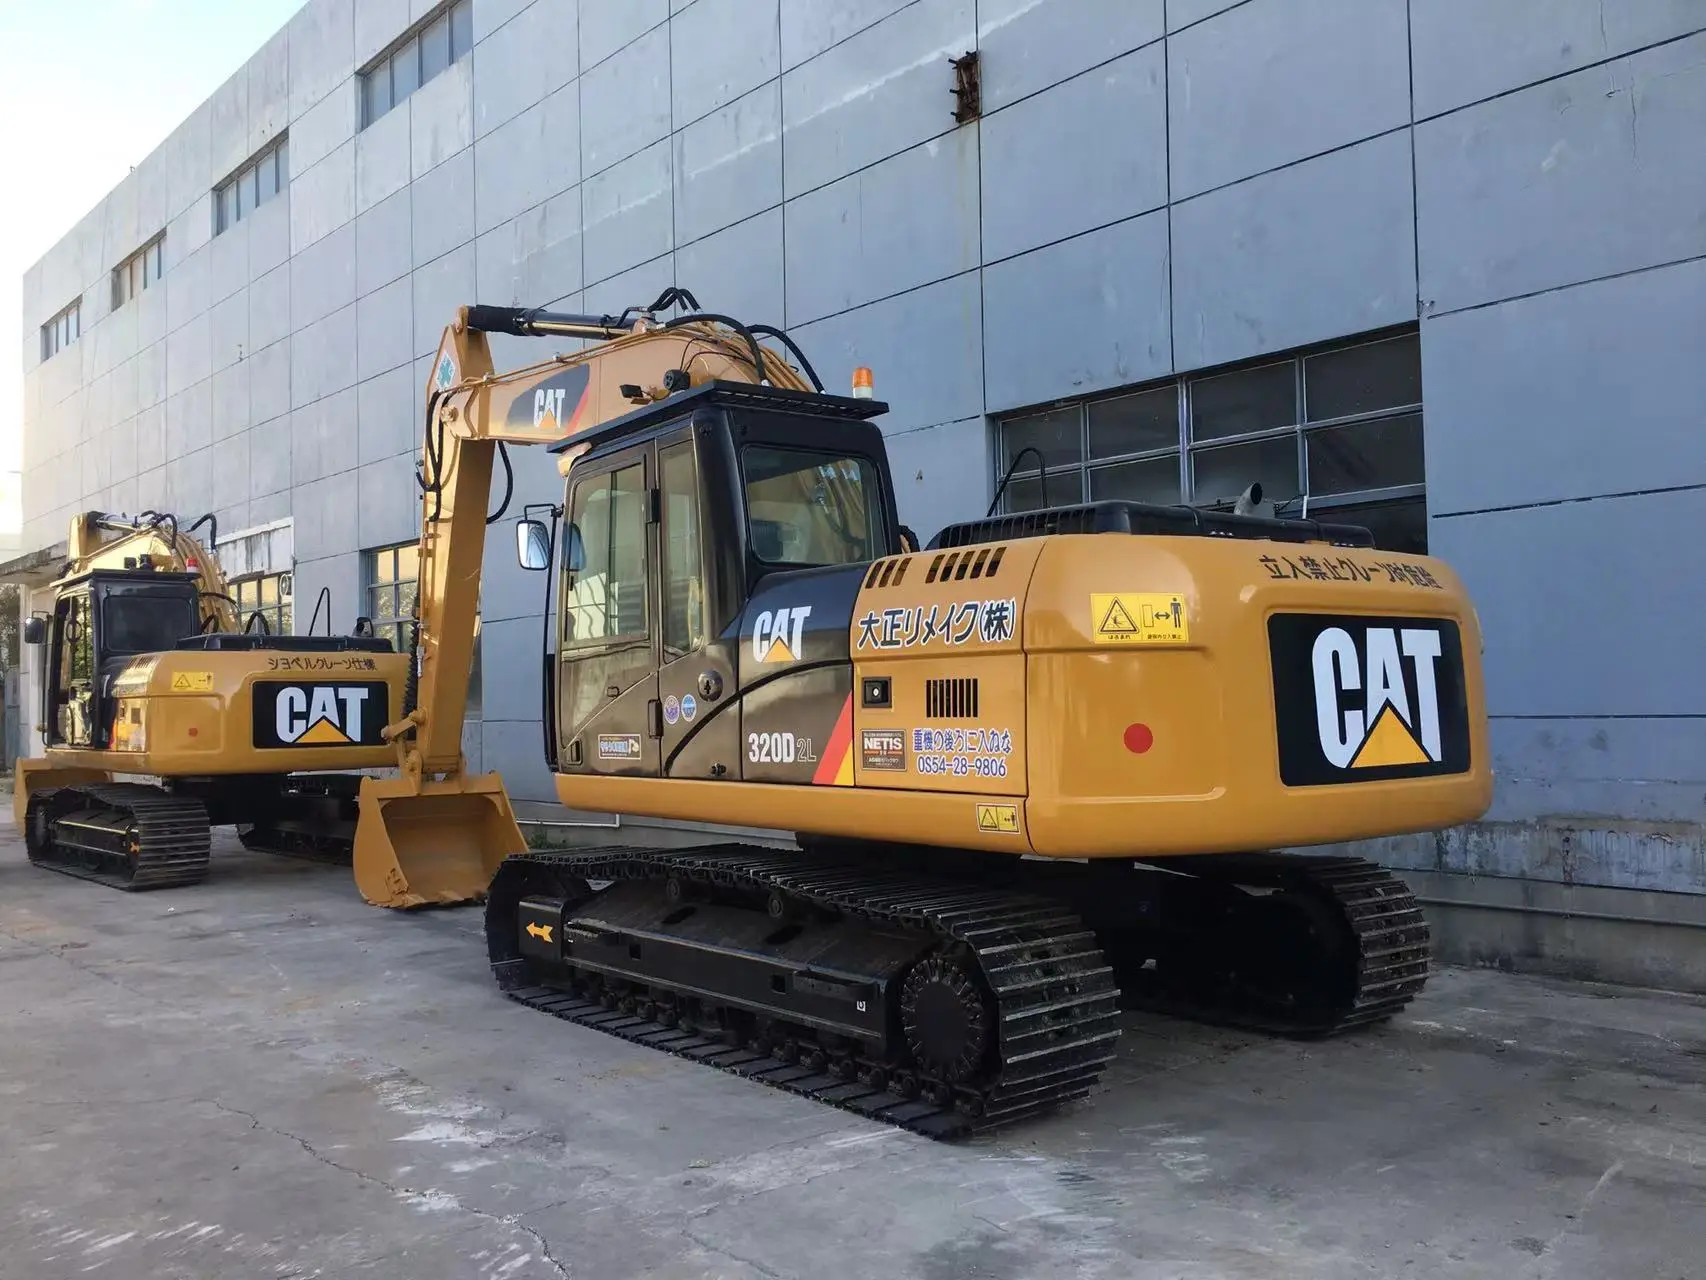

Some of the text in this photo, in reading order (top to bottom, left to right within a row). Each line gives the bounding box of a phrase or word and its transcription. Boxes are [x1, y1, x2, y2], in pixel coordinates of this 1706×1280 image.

[533, 388, 566, 429] CAT
[752, 605, 812, 663] CAT
[858, 598, 1015, 648] 大正リメイク(株)
[276, 686, 369, 743] CAT
[1312, 626, 1442, 769] CAT
[748, 732, 817, 763] 320D 2L
[863, 737, 903, 750] NETIS
